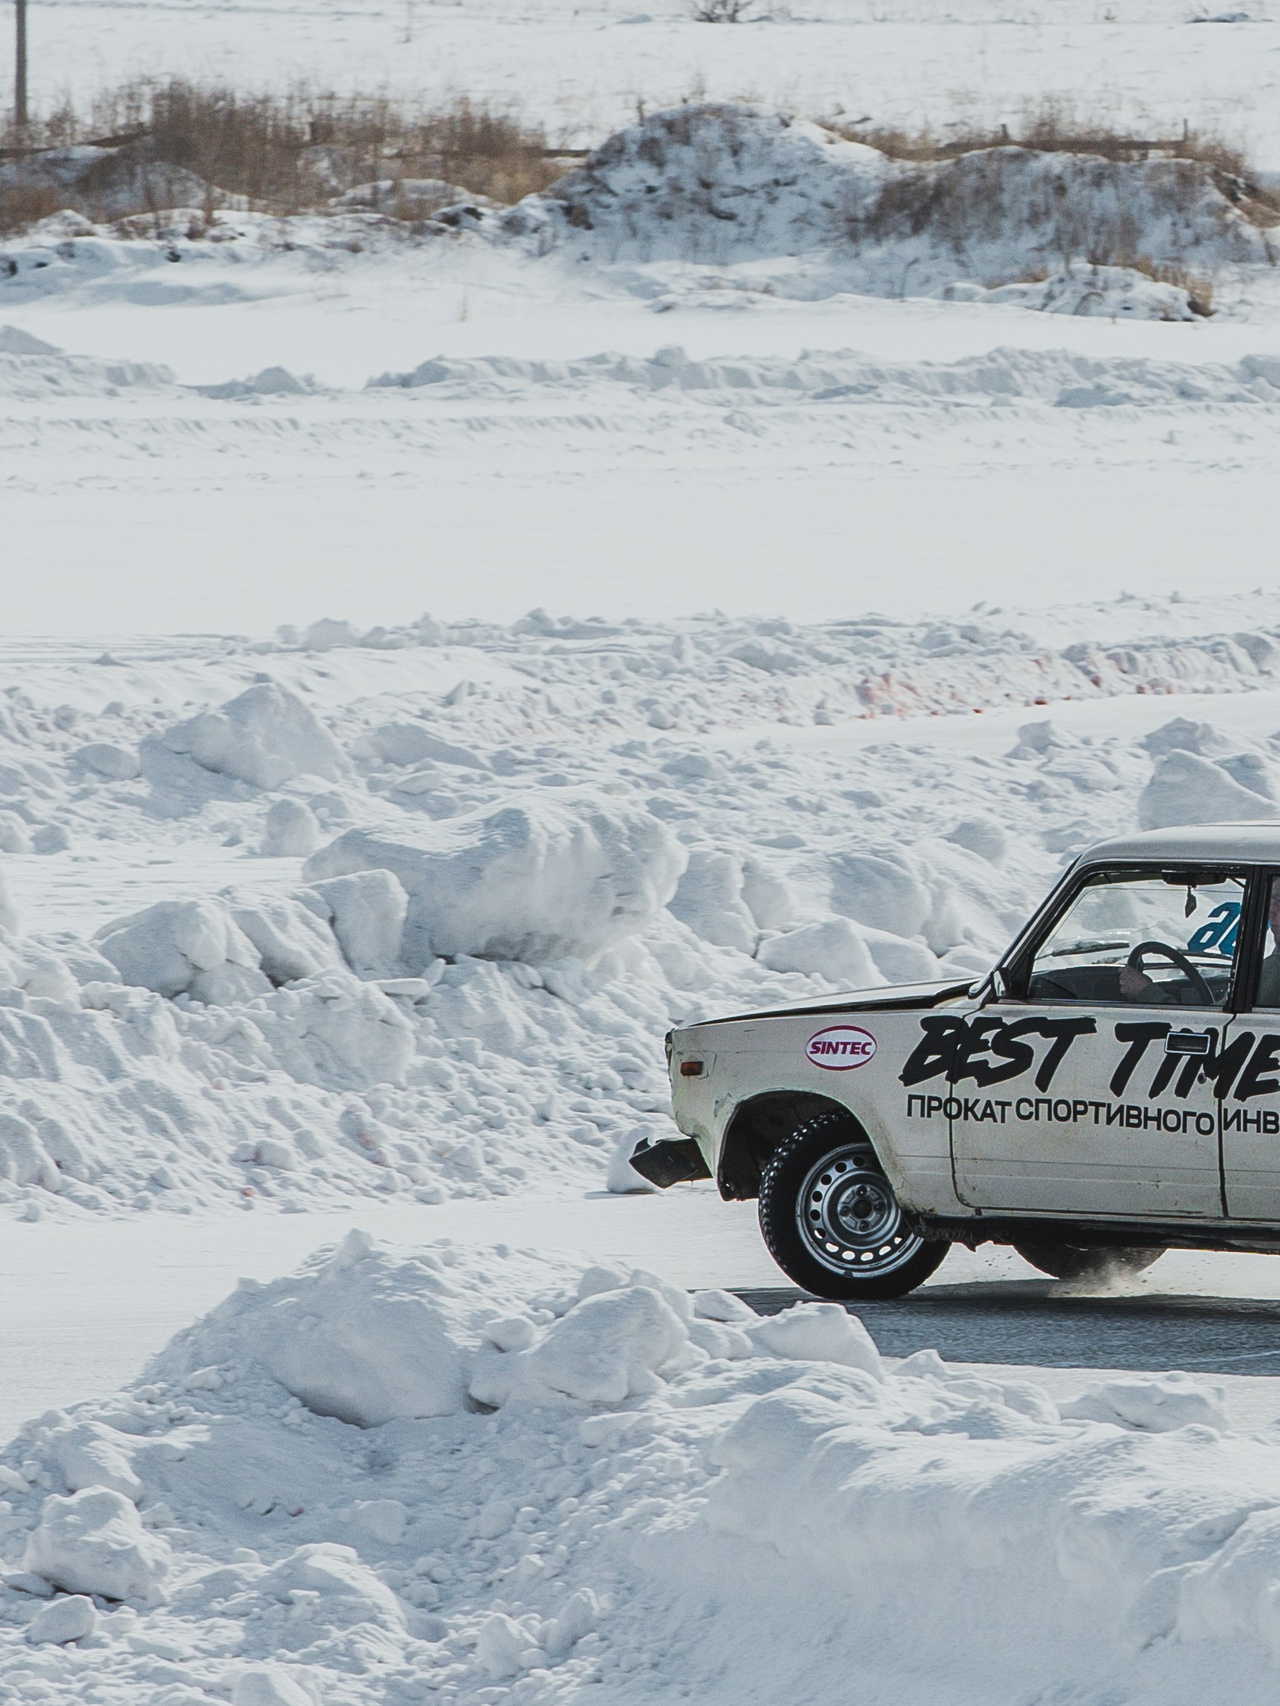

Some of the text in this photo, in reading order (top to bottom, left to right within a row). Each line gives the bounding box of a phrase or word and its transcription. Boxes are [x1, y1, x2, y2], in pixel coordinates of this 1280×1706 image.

[809, 1041, 872, 1055] SINTEC
[898, 1015, 1097, 1093] BEST
[907, 1094, 1012, 1123] ПРОКАТ
[1015, 1098, 1215, 1135] СПОРТИВНОГО
